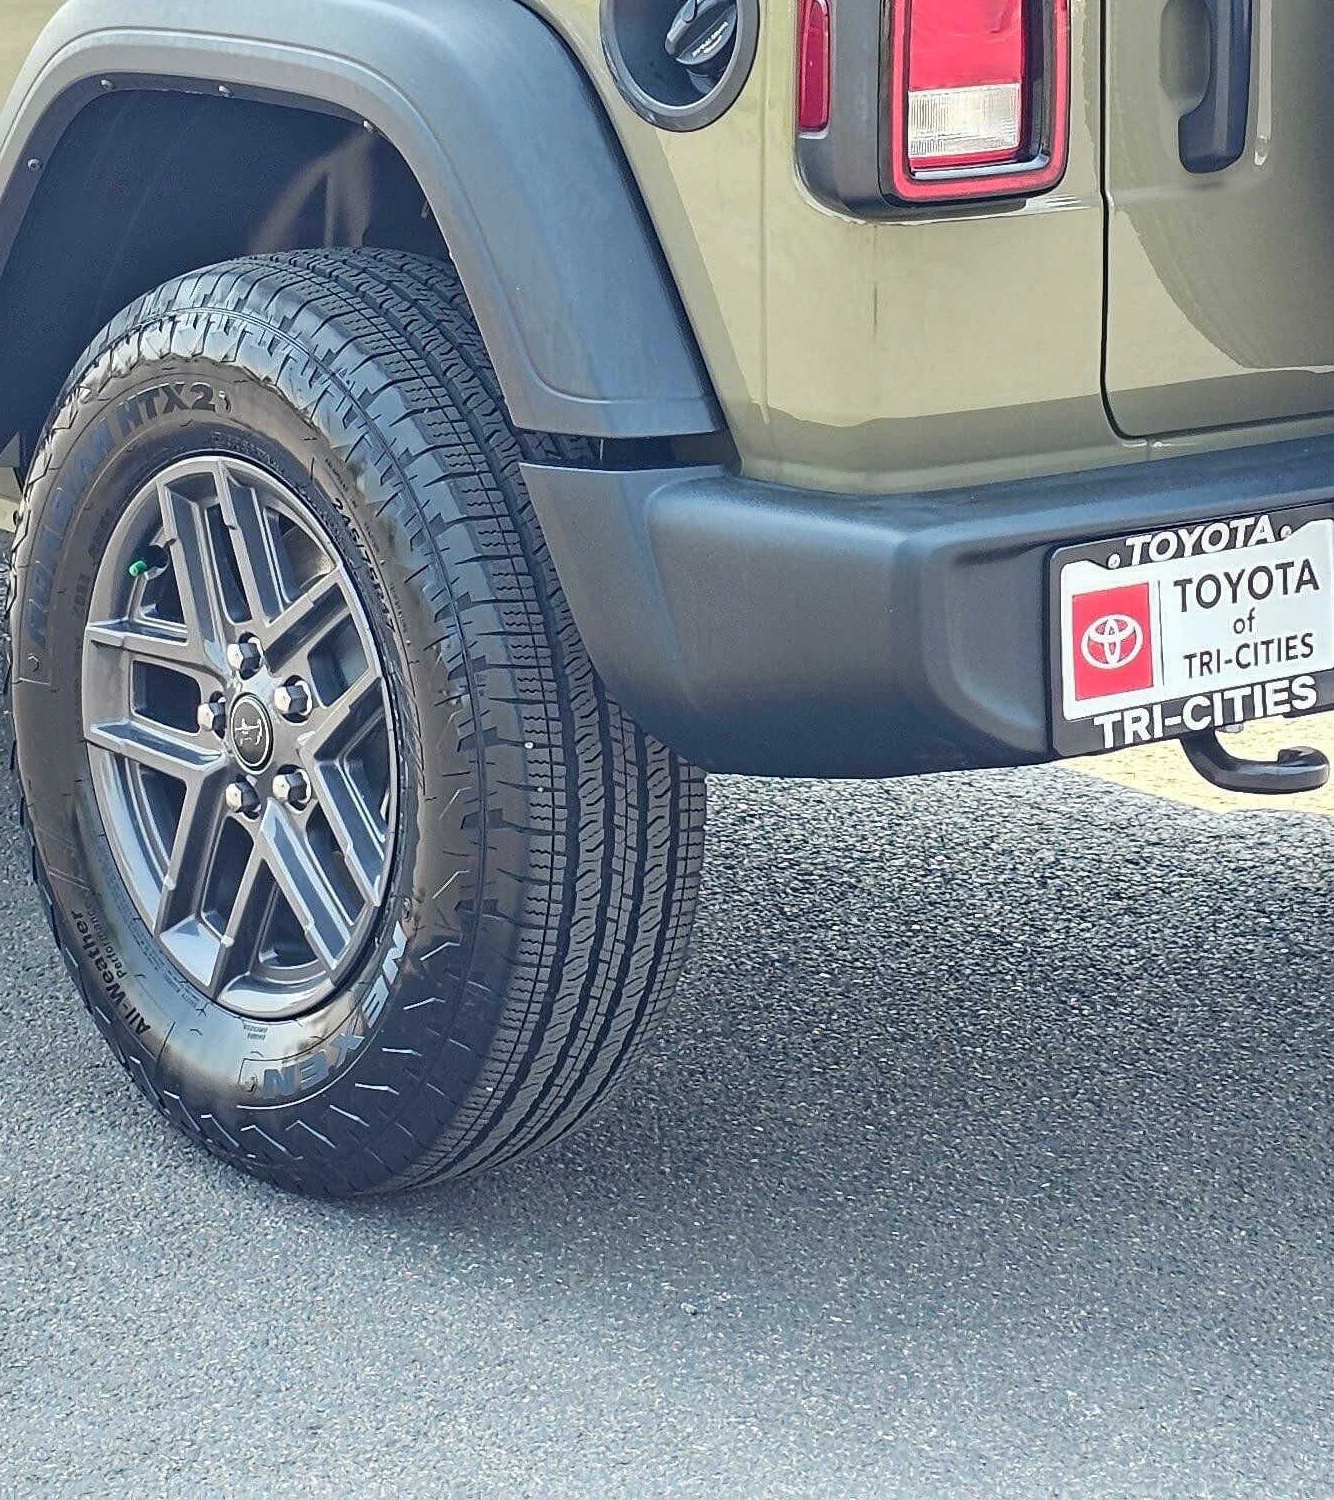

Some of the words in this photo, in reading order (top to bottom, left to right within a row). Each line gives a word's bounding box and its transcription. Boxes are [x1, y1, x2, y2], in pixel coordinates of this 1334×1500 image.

[117, 381, 217, 435] HTX2
[1125, 514, 1276, 566] TOYOTA
[1173, 558, 1320, 612] TOYOTA
[1233, 607, 1256, 634] of
[1183, 632, 1314, 679] TRI-CITIES
[1094, 675, 1317, 749] TRI-CITIES
[71, 910, 151, 1035] All-Weather
[261, 919, 408, 1099] NEXEN
